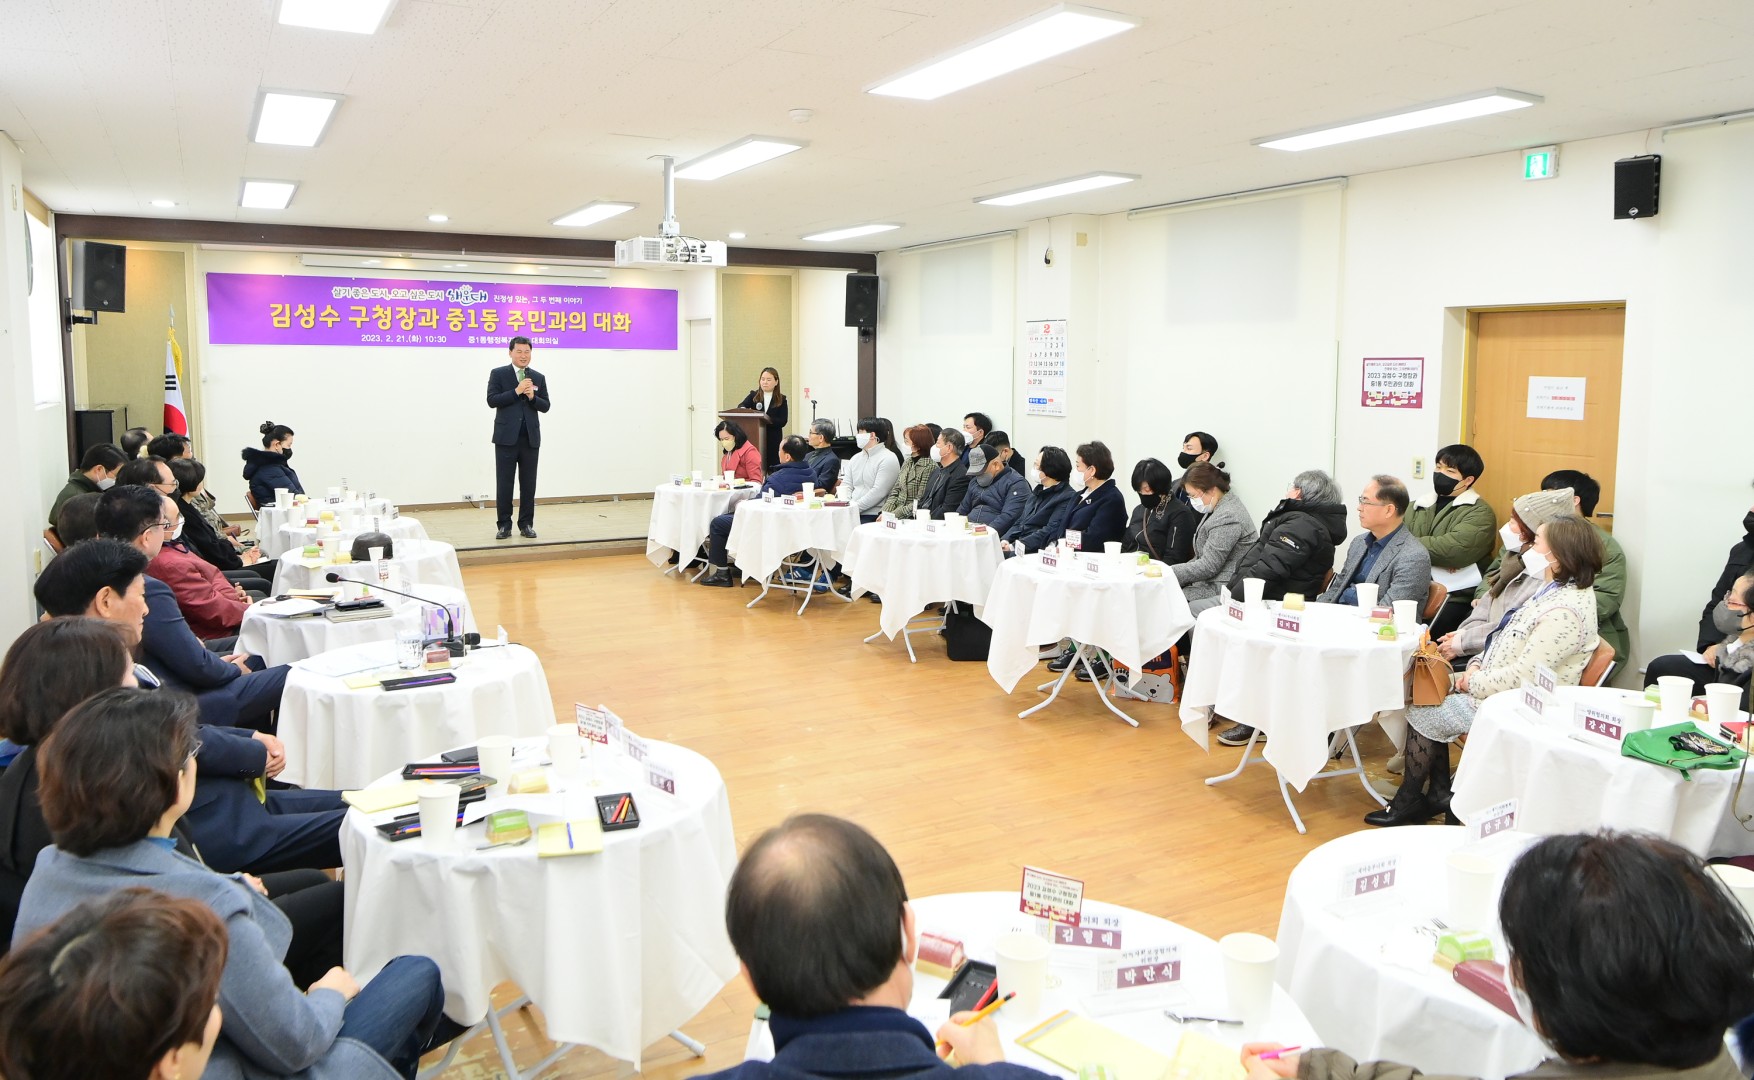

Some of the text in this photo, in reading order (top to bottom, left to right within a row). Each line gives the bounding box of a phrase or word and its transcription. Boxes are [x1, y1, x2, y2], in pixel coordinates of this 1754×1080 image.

[333, 287, 350, 298] 살기
[352, 287, 369, 298] 좋은
[392, 289, 408, 299] 오고
[409, 290, 426, 300] 싶은
[428, 290, 444, 300] 도시
[447, 285, 488, 305] 해운대
[494, 294, 512, 303] 진정성
[548, 296, 561, 304] 번째
[269, 303, 632, 333] 김성수 구청장과 중1동 주민과의 대화
[1043, 323, 1051, 334] 2
[361, 334, 447, 344] 2023. 2. 21.(화) 10:30
[531, 336, 559, 345] 대회의실
[1123, 962, 1174, 985] 박만식
